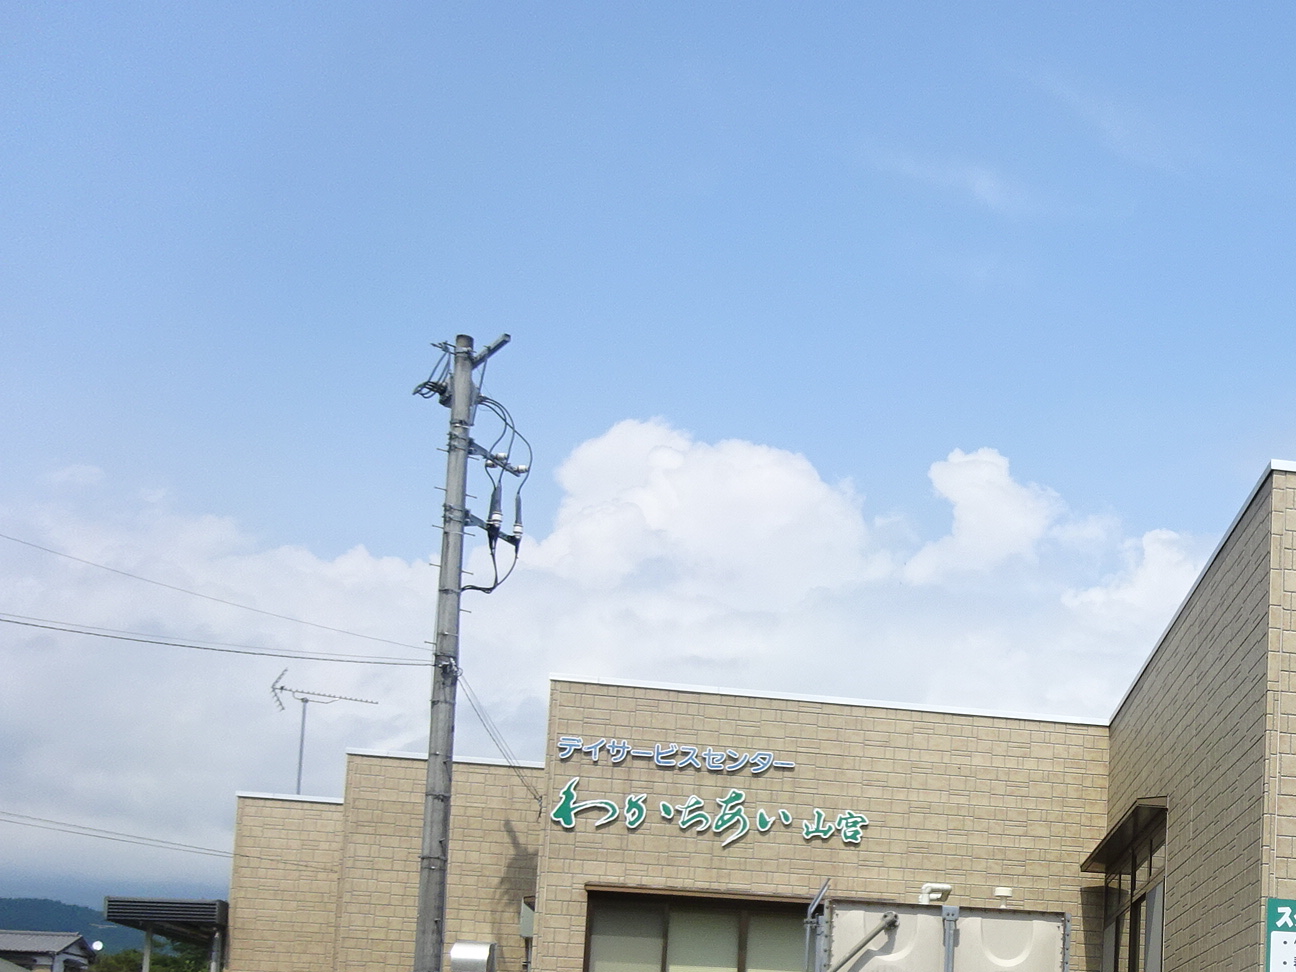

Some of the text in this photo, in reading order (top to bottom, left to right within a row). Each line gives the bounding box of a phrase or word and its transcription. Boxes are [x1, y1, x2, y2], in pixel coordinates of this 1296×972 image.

[557, 736, 795, 774] デイサービスセンター
